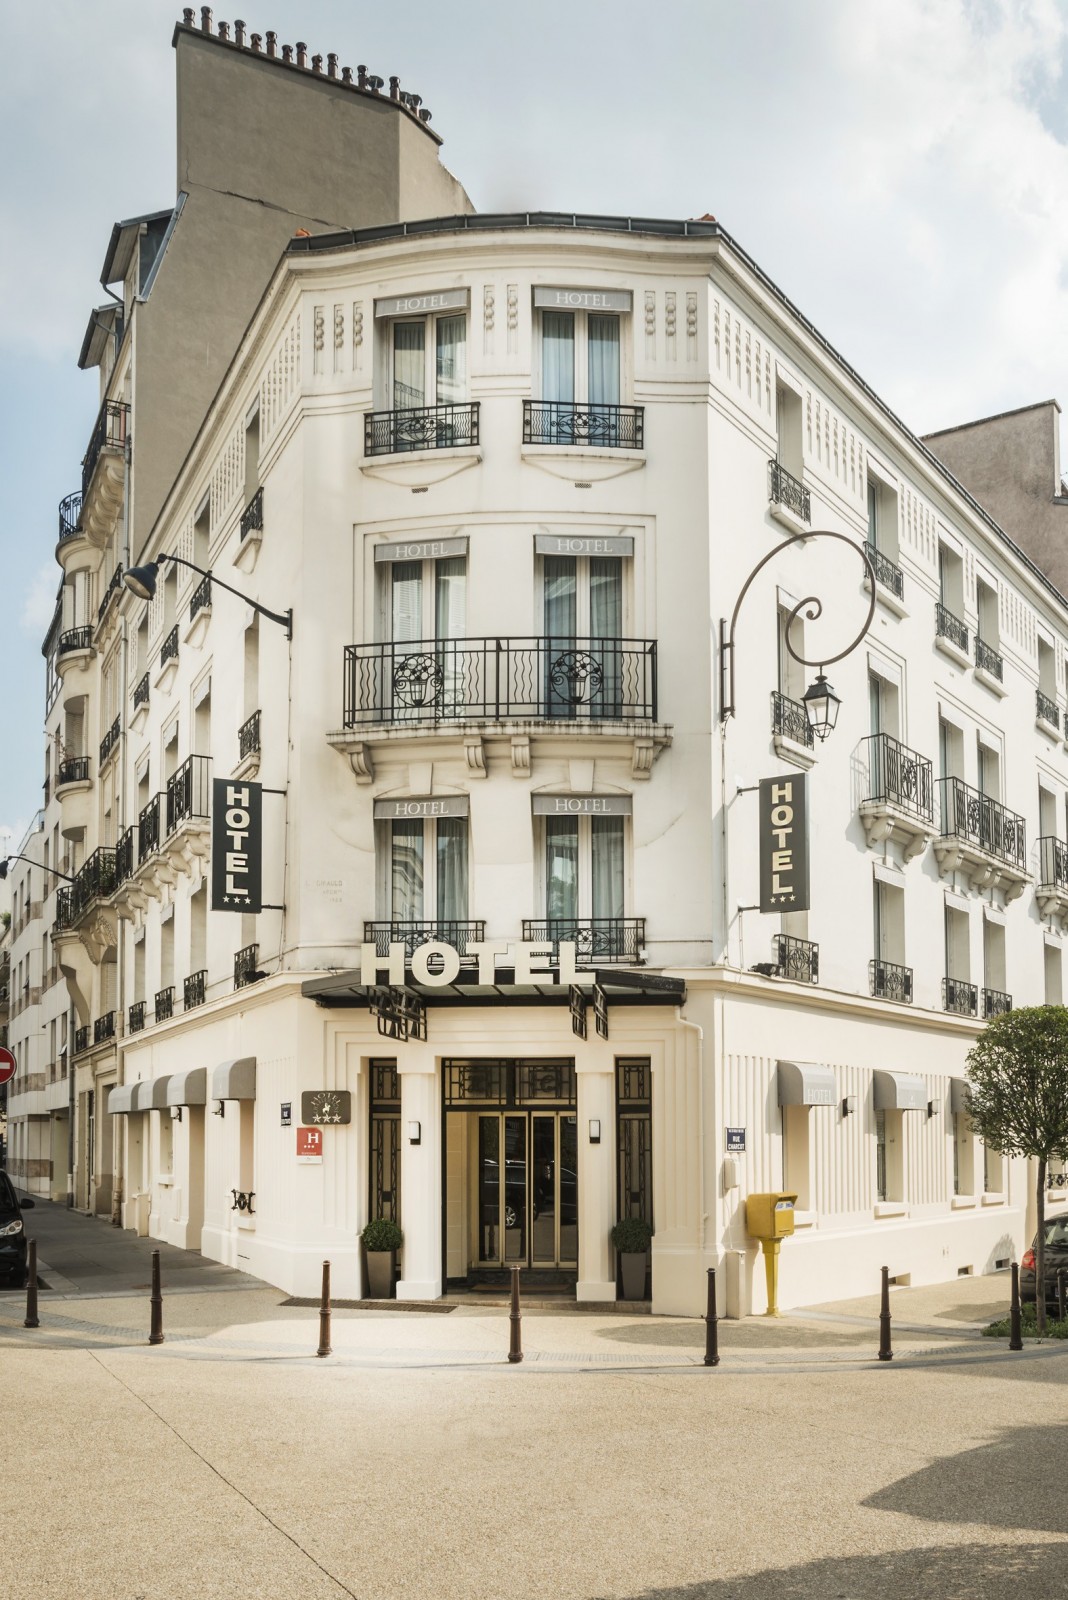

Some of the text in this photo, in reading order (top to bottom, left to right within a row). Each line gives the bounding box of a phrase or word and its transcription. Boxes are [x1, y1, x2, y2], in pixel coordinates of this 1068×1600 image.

[395, 294, 448, 311] HOTEL
[555, 291, 611, 307] HOTEL
[395, 542, 448, 558] HOTEL
[557, 538, 612, 552] HOTEL
[394, 801, 449, 816] HOTEL
[555, 798, 611, 812] HOTEL
[225, 785, 250, 895] HOTEL
[771, 782, 794, 895] HOTEL
[360, 941, 596, 987] HOTEL
[311, 1092, 341, 1106] HOTEL
[808, 1088, 832, 1103] HOTEL
[307, 1132, 319, 1144] H
